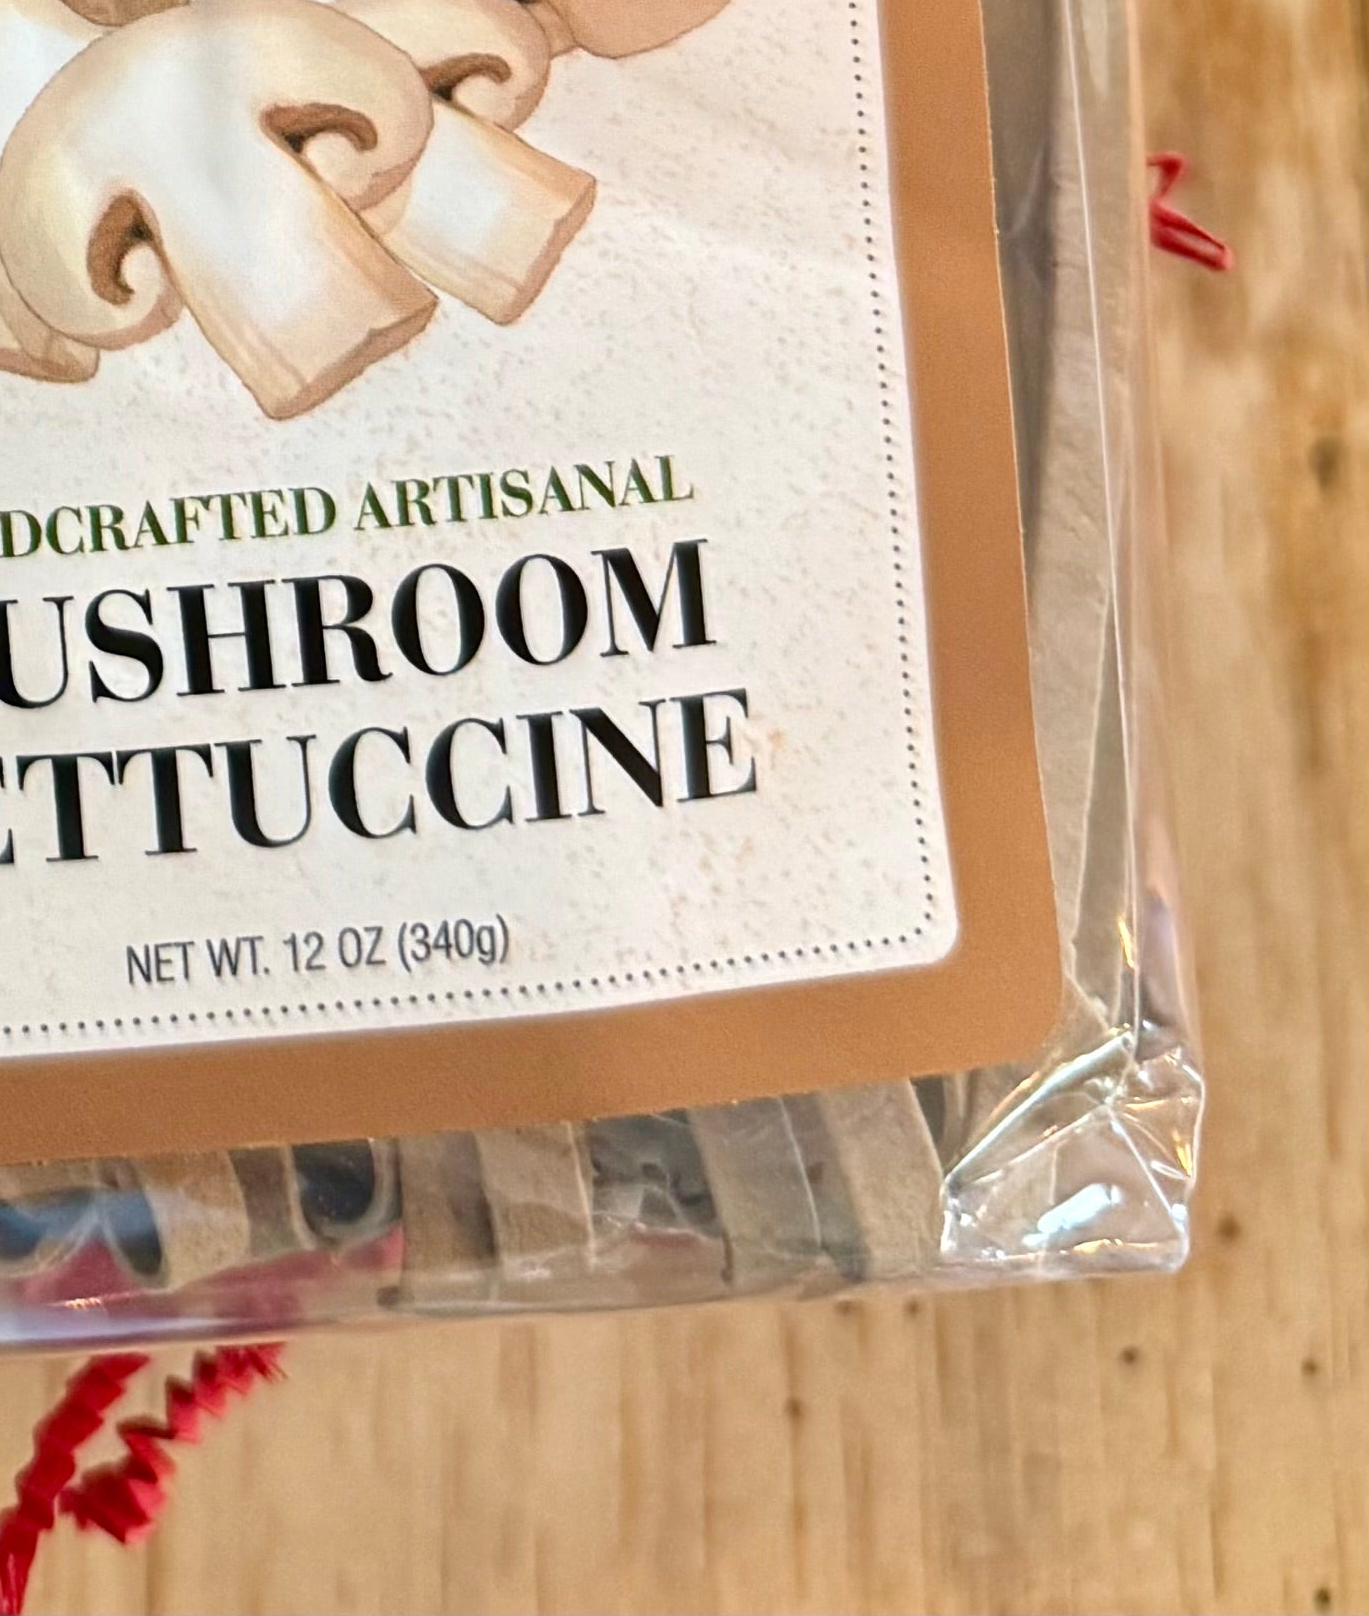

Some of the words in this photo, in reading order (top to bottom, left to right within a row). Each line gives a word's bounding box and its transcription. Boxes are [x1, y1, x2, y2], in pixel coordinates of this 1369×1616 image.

[351, 453, 695, 532] ARTISANAL
[126, 940, 195, 986] NET
[205, 934, 272, 979] WT.
[282, 931, 328, 973] 12
[337, 925, 387, 969] OZ
[397, 913, 510, 973] (340g)
